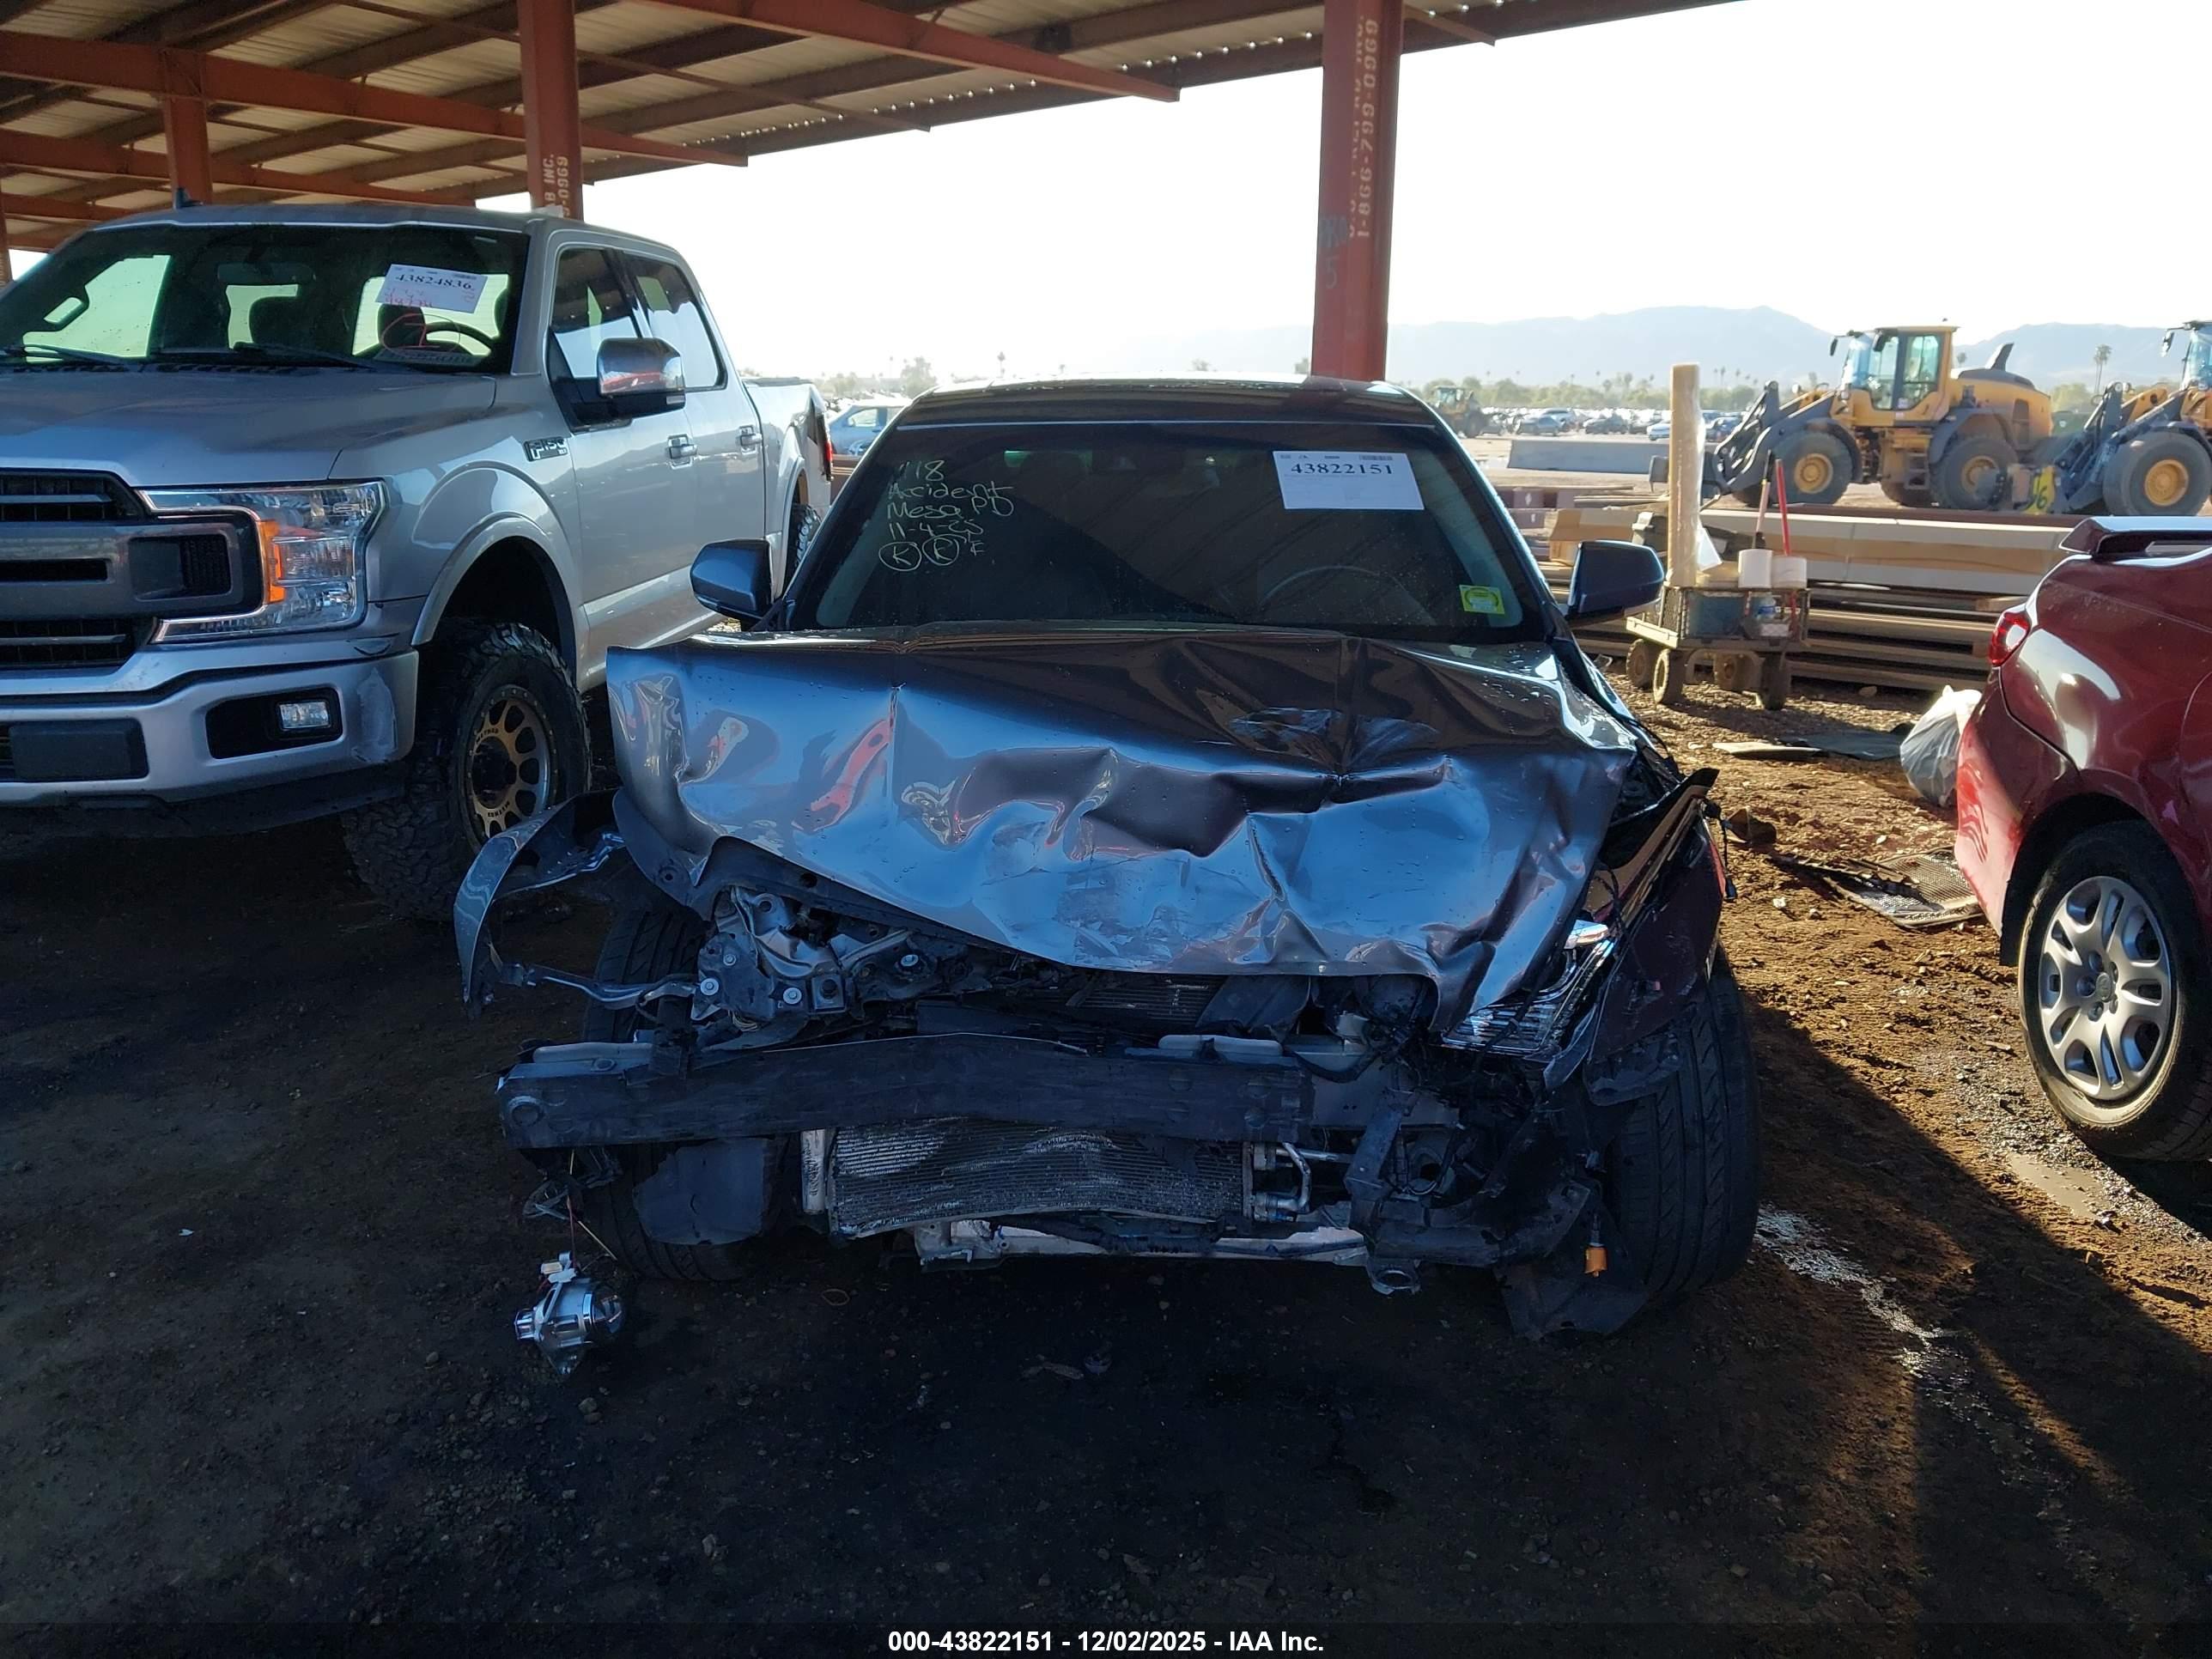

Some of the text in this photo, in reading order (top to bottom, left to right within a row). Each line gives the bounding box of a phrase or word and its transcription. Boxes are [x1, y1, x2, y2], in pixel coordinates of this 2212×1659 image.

[1357, 19, 1378, 237] 1-866-799-0969
[542, 154, 556, 184] INC.
[395, 273, 472, 290] 43824836
[1291, 463, 1394, 475] 43822151
[888, 481, 1014, 500] Accident
[887, 501, 964, 520] Mesa
